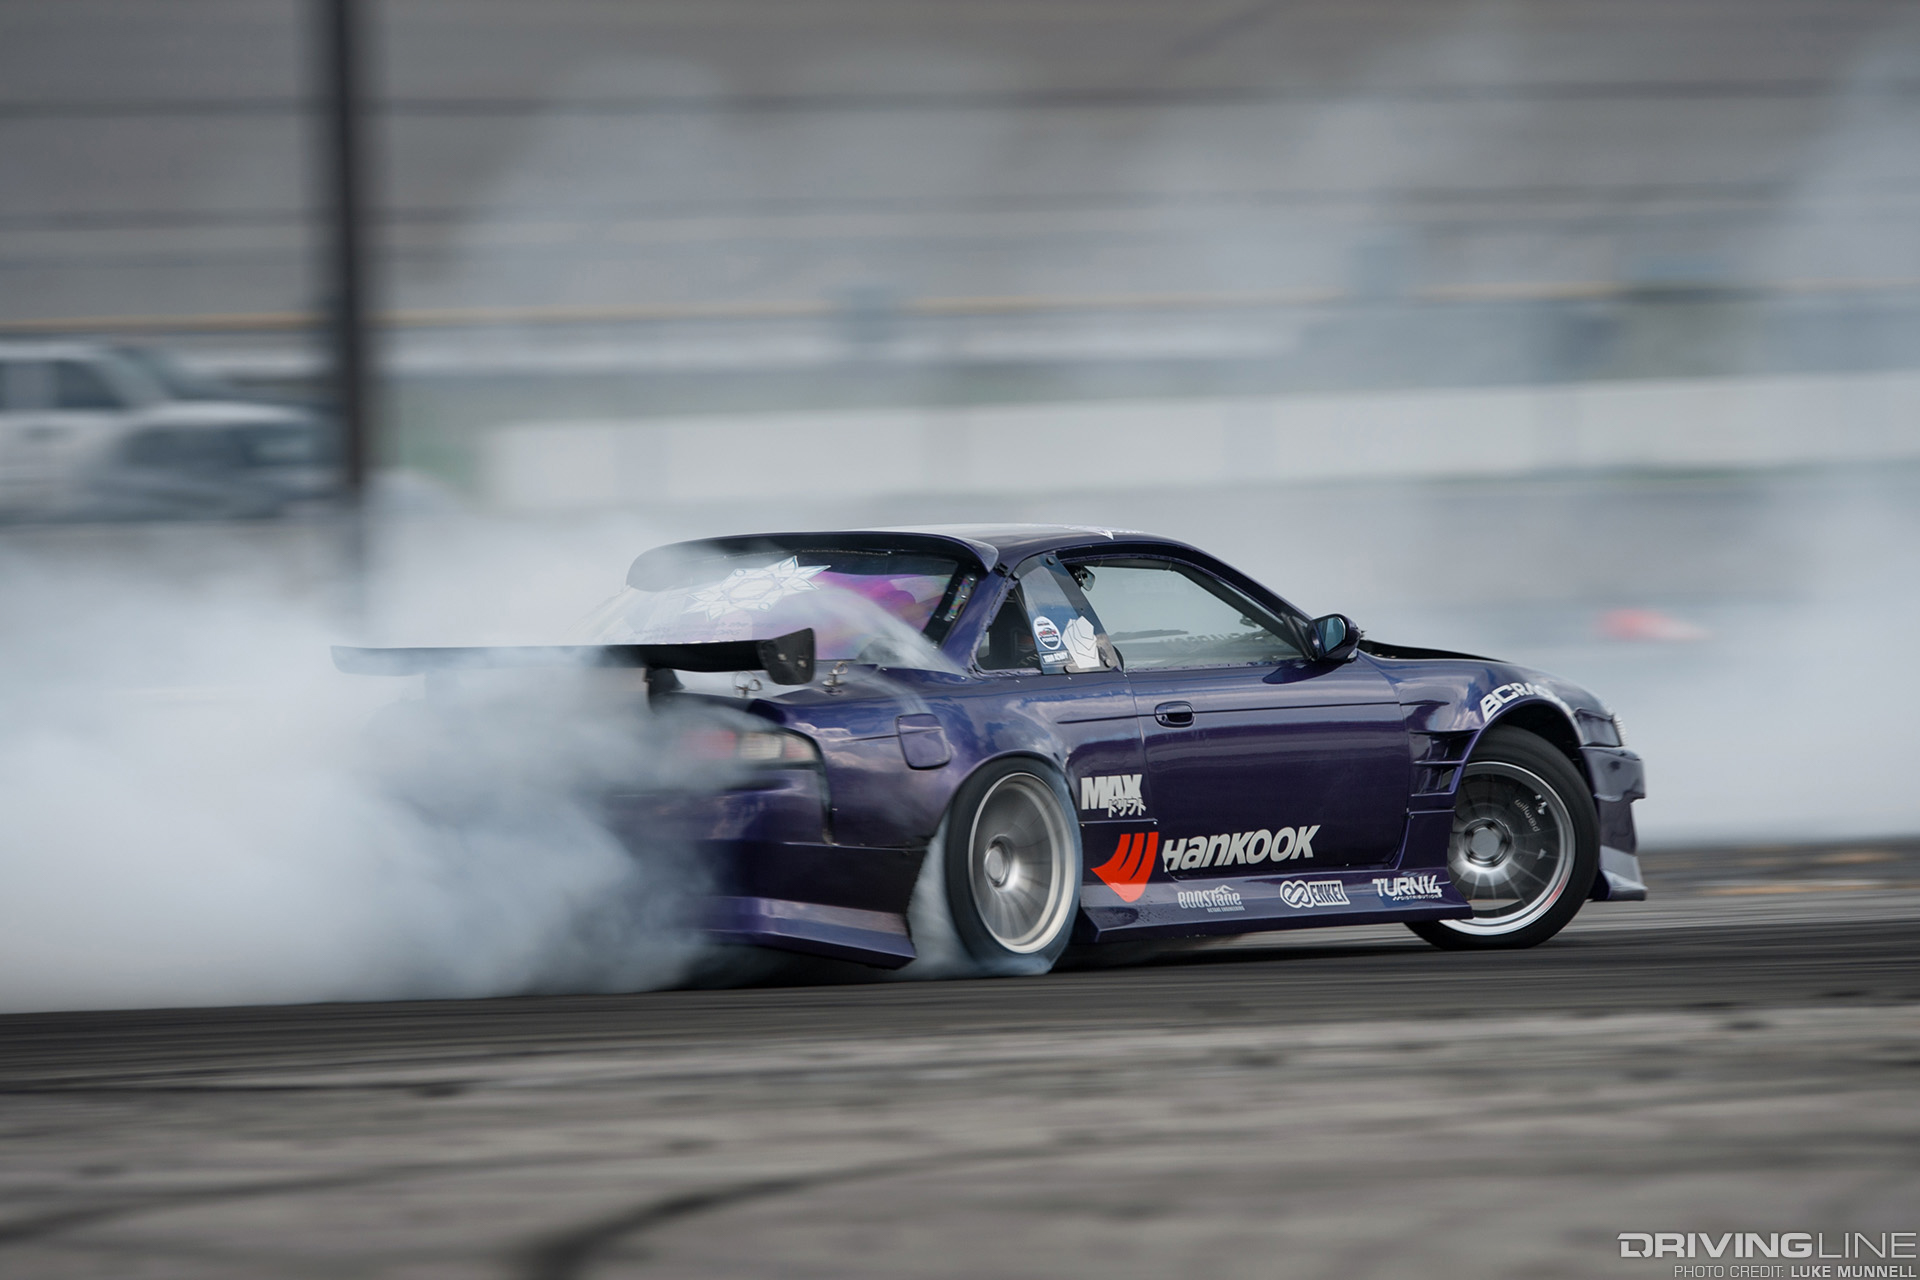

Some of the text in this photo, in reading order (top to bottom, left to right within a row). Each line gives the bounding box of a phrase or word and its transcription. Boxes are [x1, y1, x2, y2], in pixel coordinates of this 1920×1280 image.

[1081, 774, 1142, 810] MAX
[1310, 883, 1347, 904] ENKEI
[1372, 875, 1442, 898] TURN14
